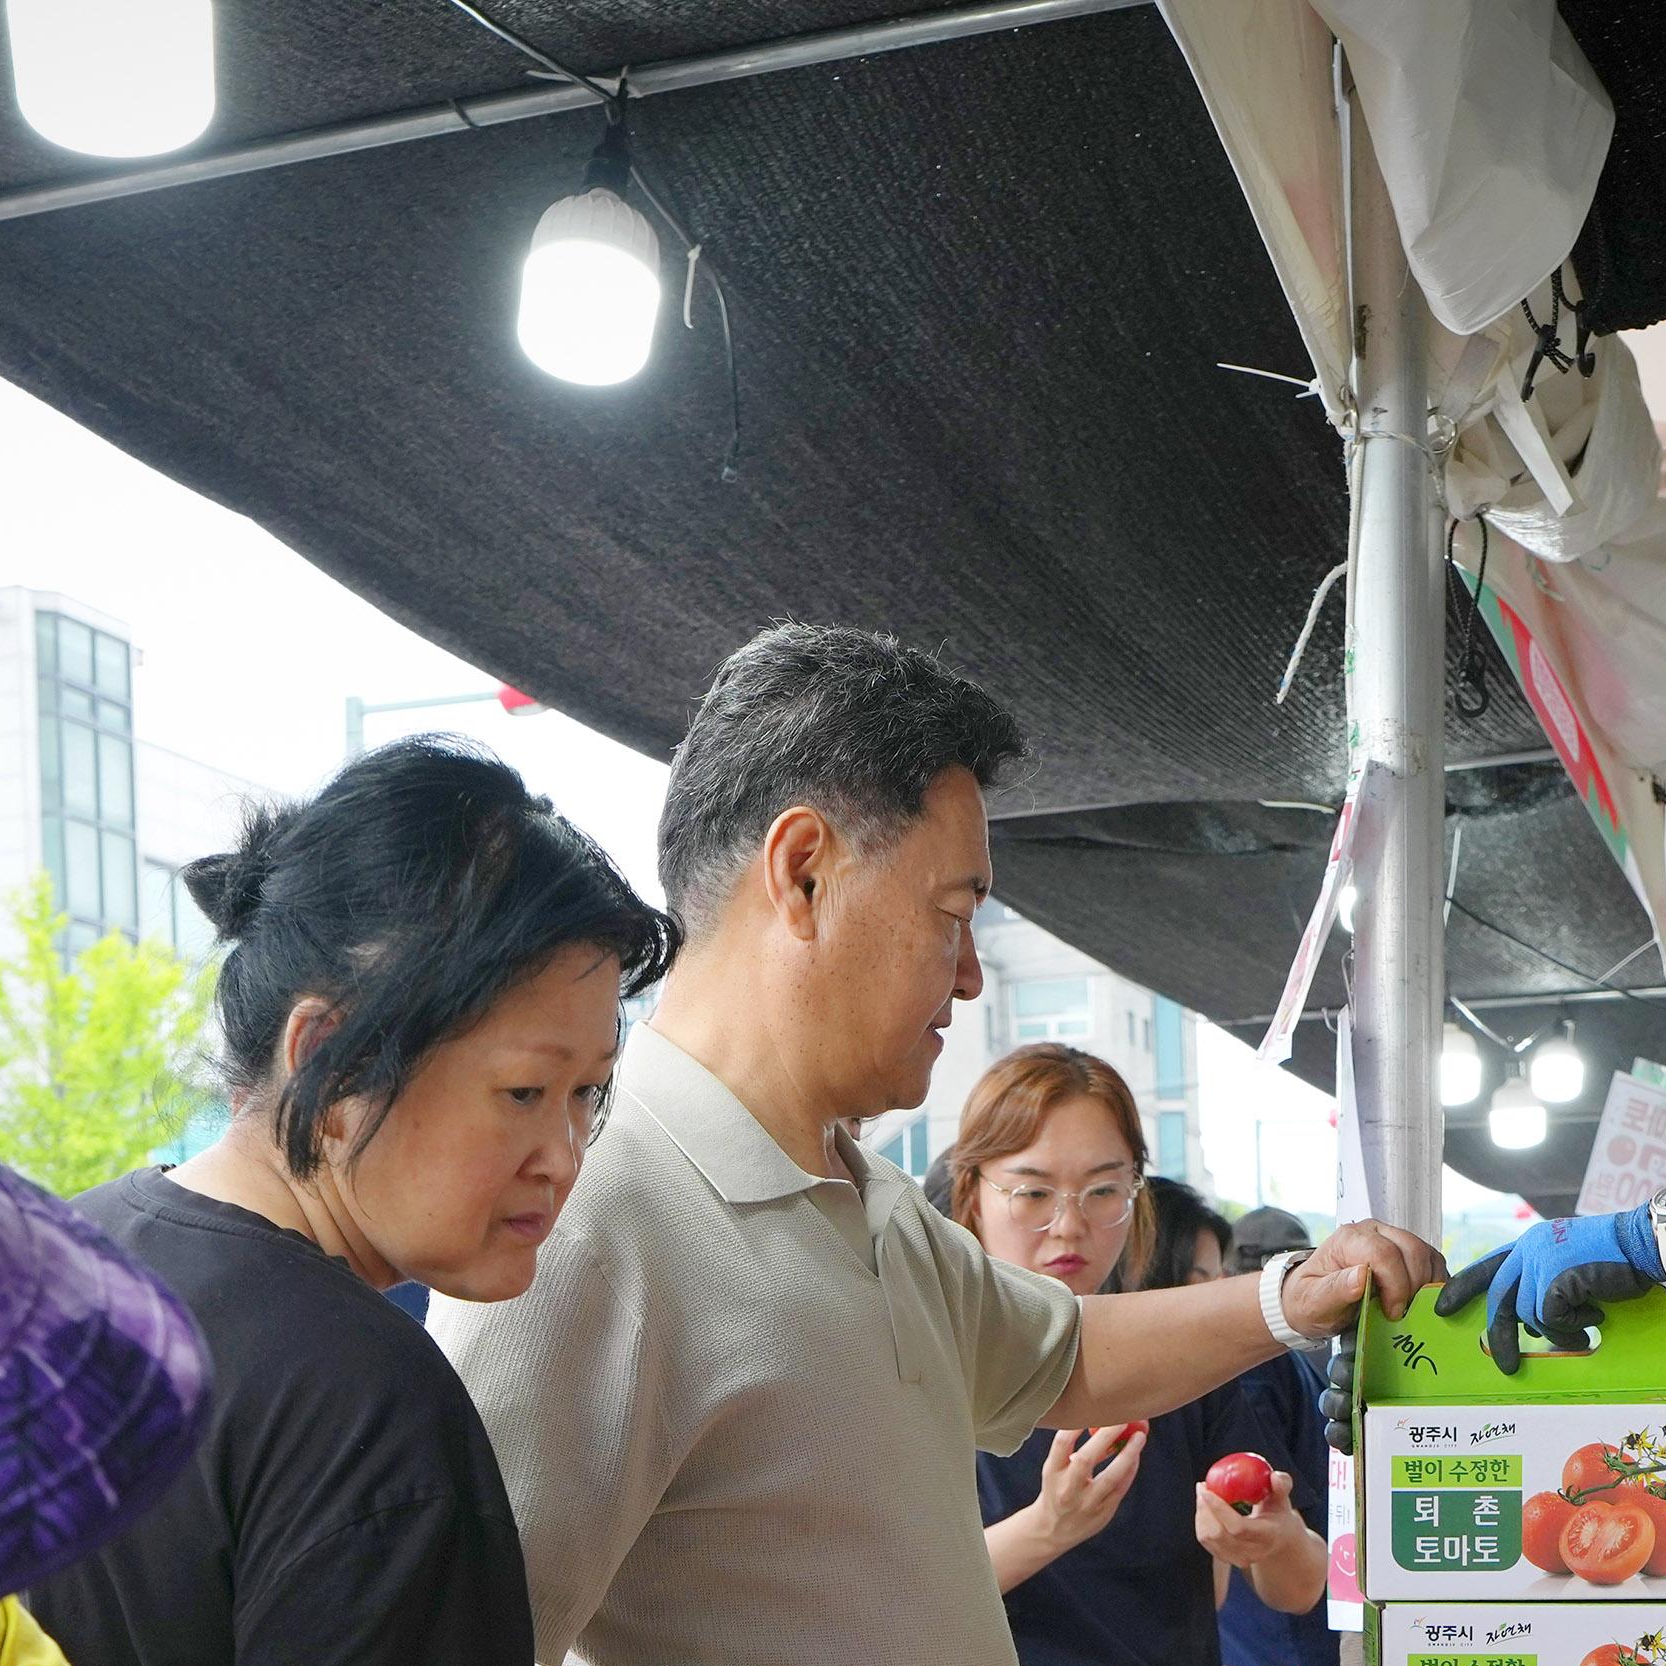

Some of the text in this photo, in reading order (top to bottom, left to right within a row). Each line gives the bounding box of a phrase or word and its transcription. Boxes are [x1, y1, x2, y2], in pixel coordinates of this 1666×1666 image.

[1408, 1426, 1458, 1443] 광주시
[1404, 1459, 1510, 1483] 벌이 수정한
[1413, 1535, 1501, 1566] 토마토
[1425, 1625, 1473, 1642] 광주시
